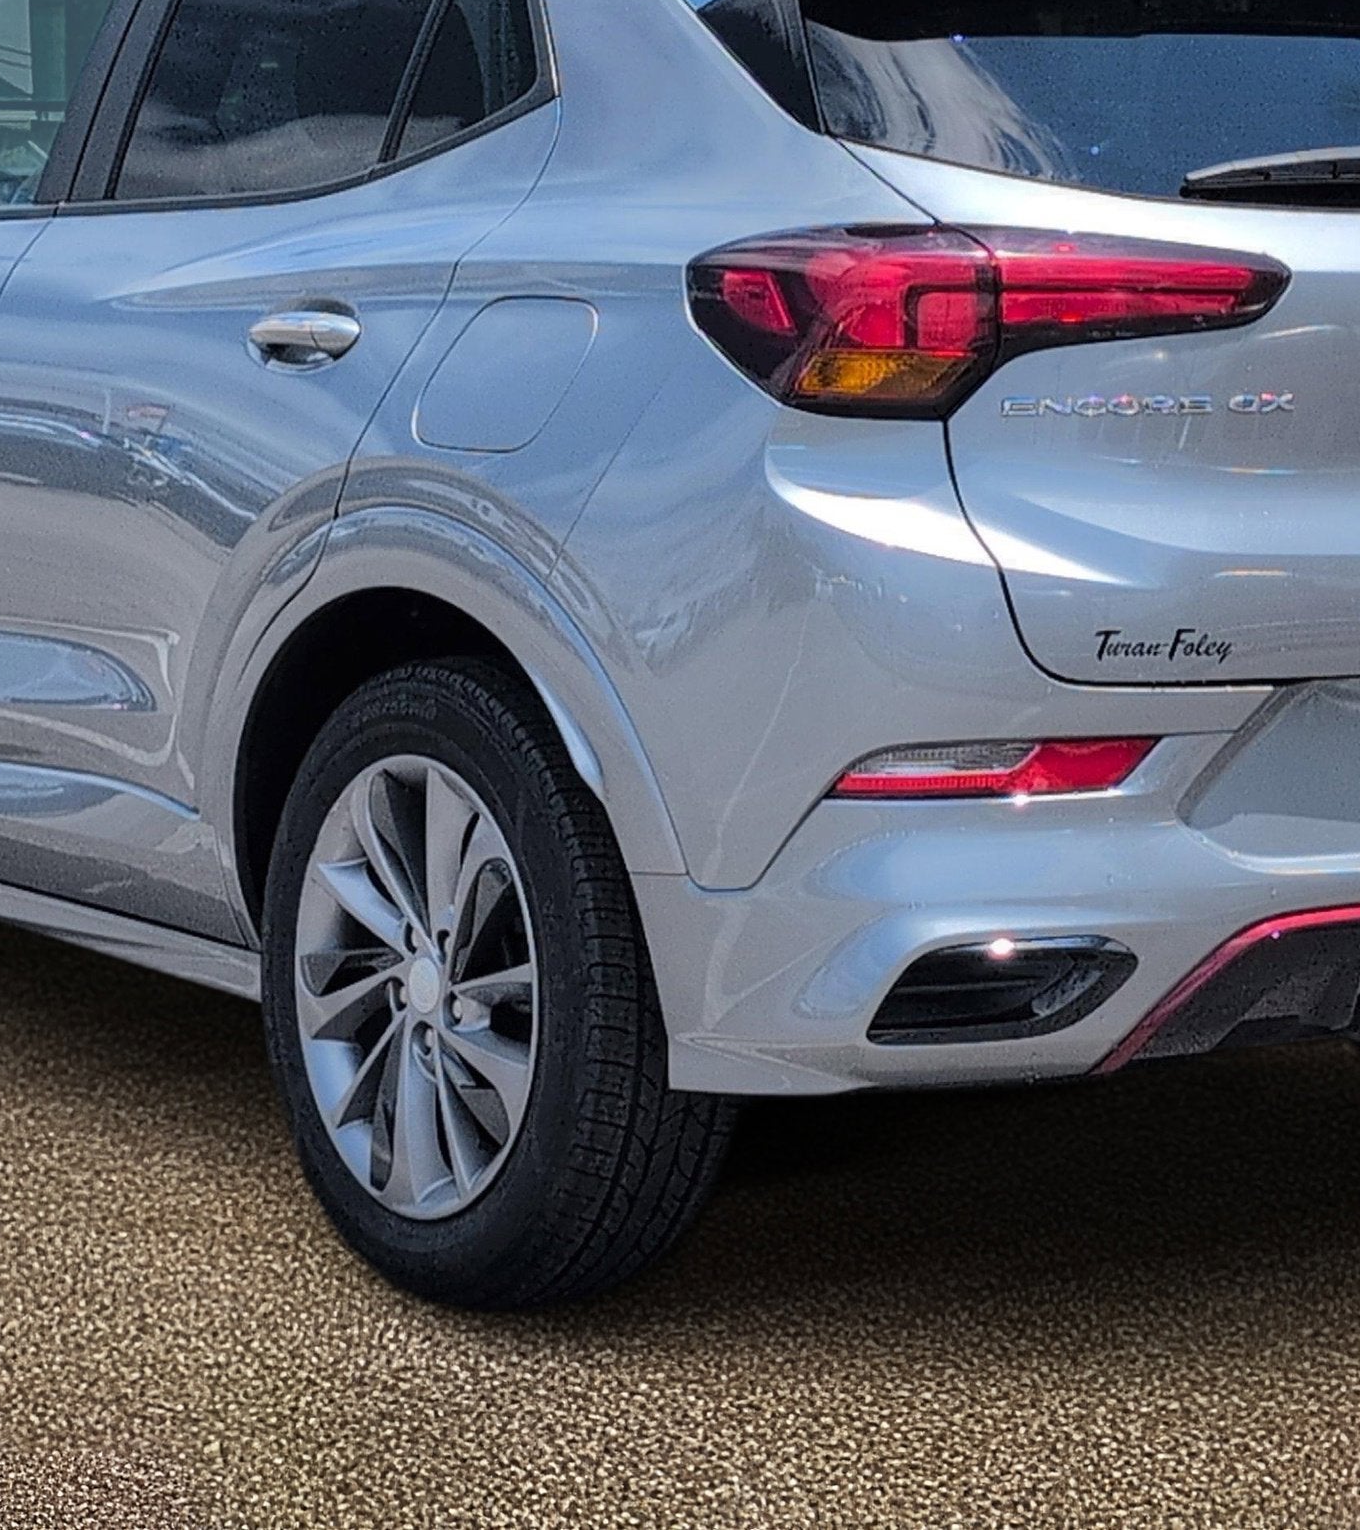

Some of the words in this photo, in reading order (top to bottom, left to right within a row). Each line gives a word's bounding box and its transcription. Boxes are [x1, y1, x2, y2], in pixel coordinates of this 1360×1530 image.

[1000, 395, 1213, 416] ENCORE
[1227, 391, 1295, 413] GX
[1095, 629, 1161, 662] Turan
[1168, 628, 1233, 664] Foley
